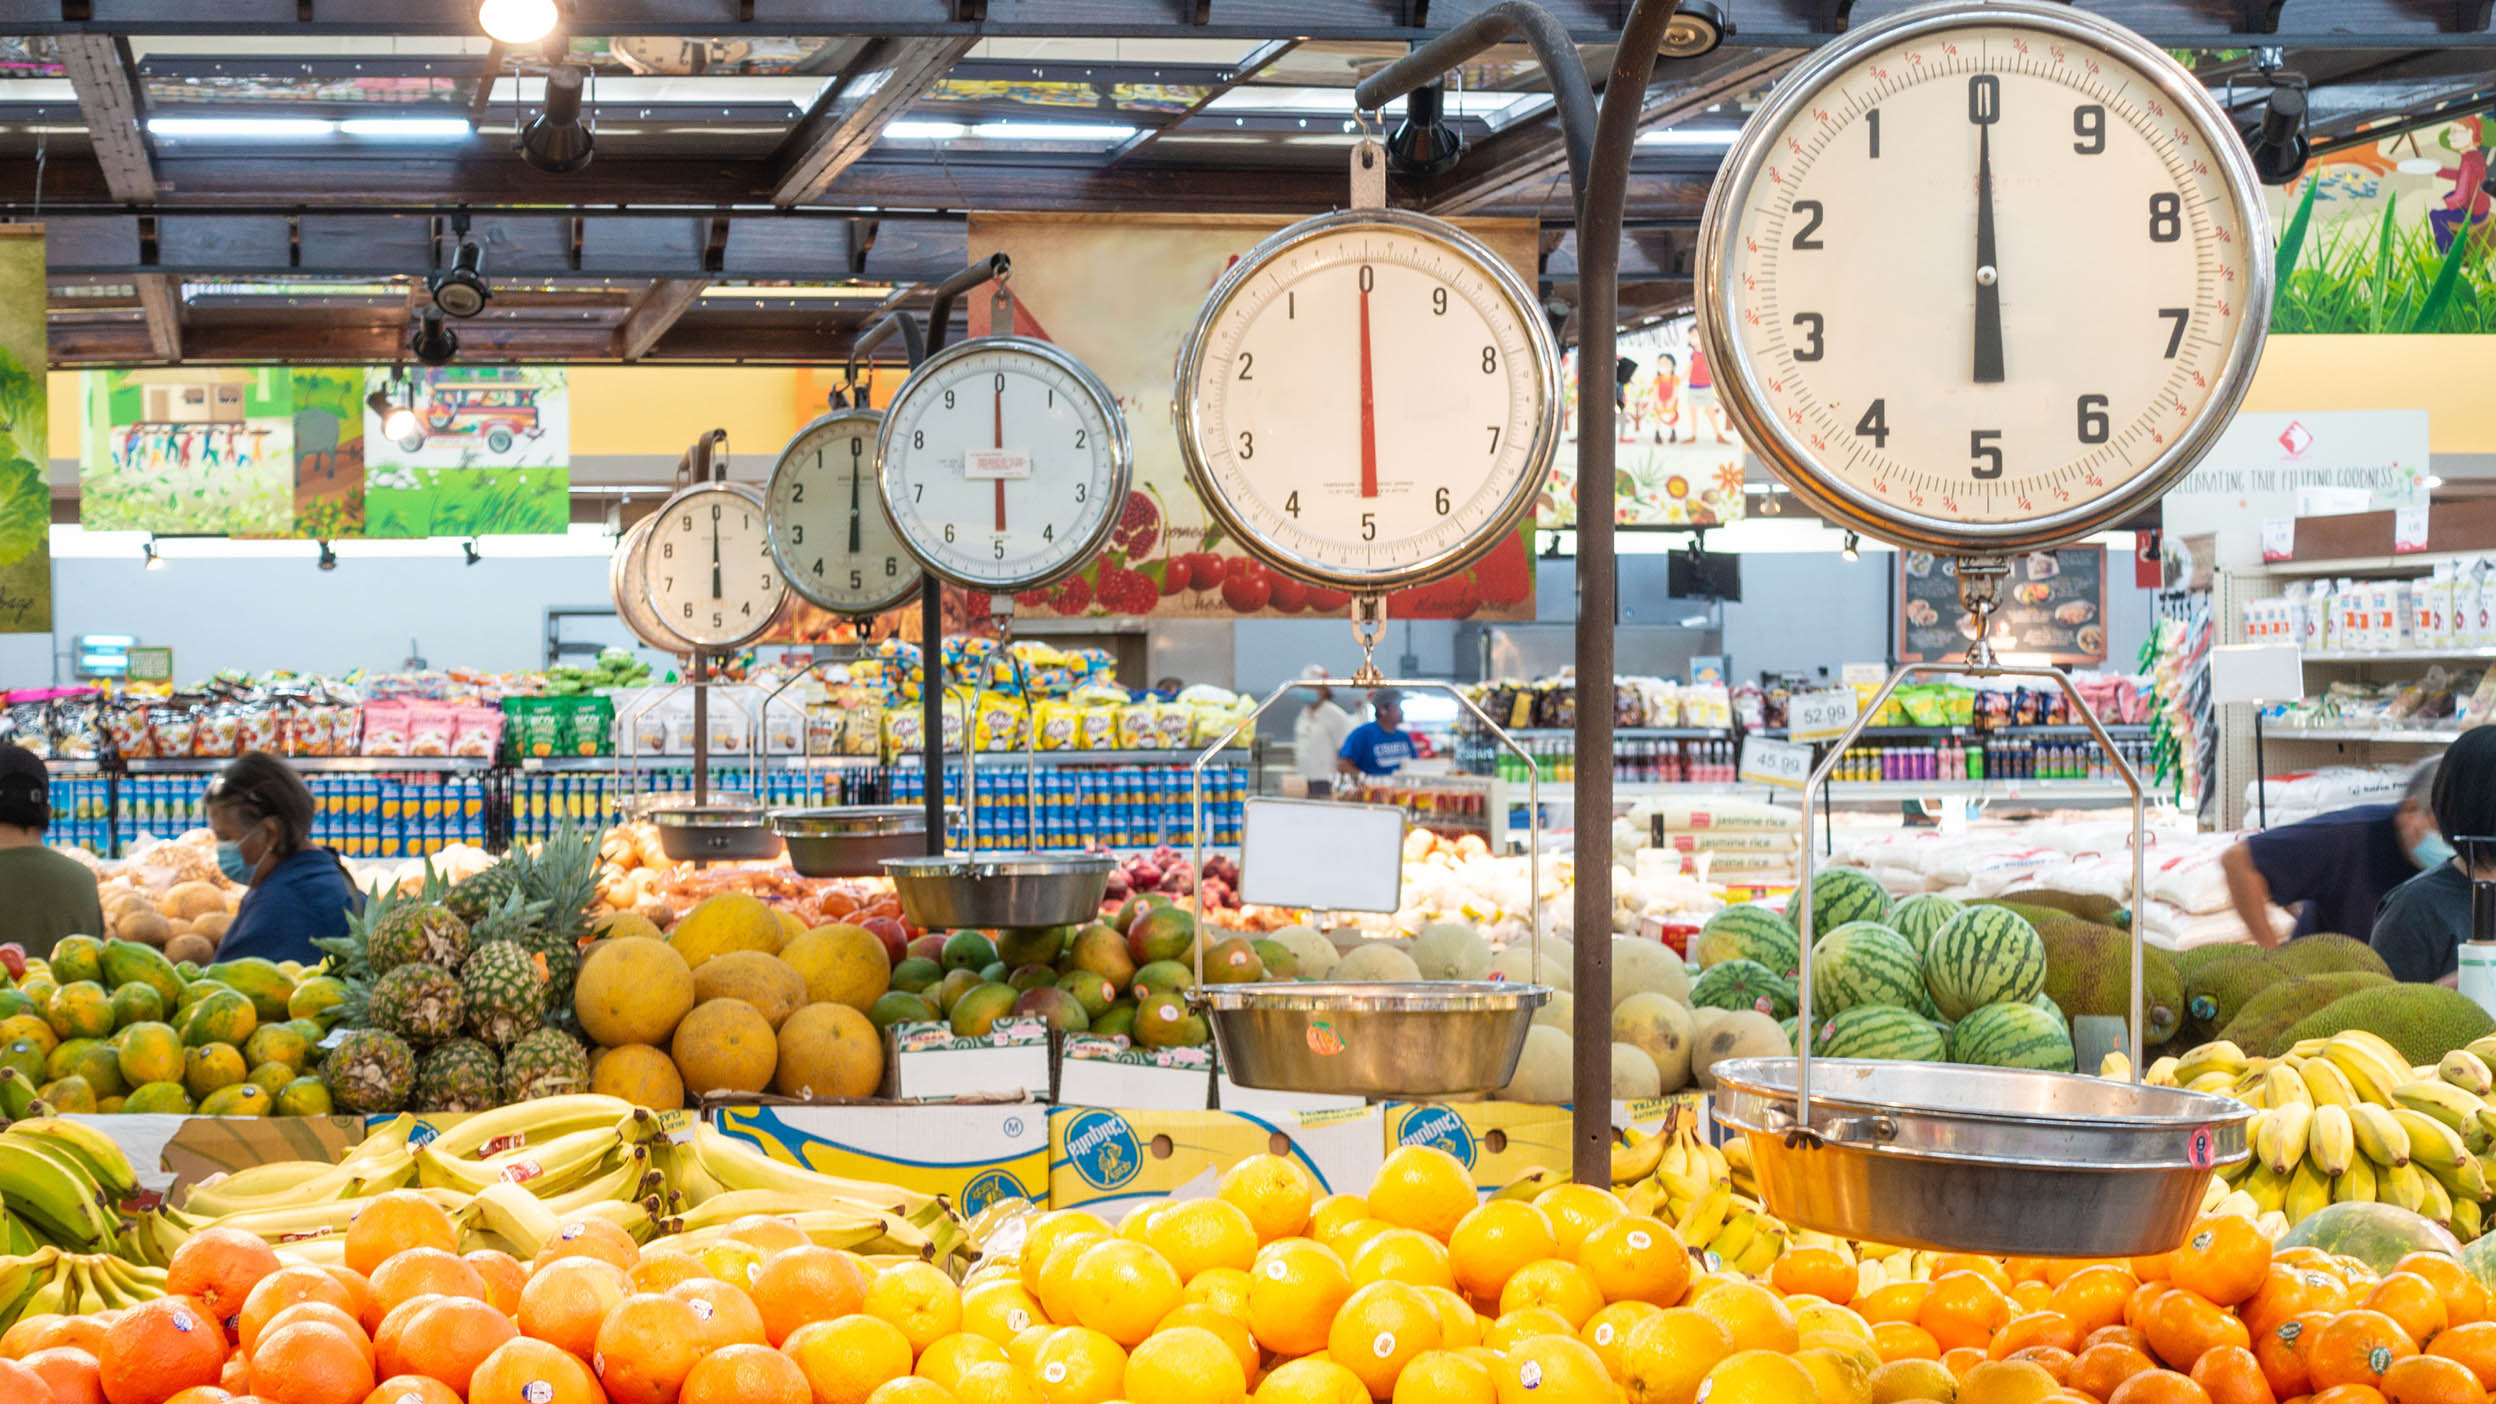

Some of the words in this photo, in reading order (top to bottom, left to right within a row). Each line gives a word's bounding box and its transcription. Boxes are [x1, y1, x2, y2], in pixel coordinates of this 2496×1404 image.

[1969, 75, 1999, 124] 0
[1866, 109, 1879, 158] 1
[2074, 105, 2105, 155] 9
[1792, 200, 1823, 250] 2
[2150, 192, 2181, 242] 8
[1359, 265, 1374, 293] 0
[1289, 292, 1294, 319] 1
[1433, 288, 1447, 315] 9
[1793, 313, 1823, 361] 3
[2159, 308, 2189, 358] 7
[1239, 353, 1252, 380] 2
[1482, 346, 1496, 374] 8
[995, 373, 1004, 392] 0
[945, 390, 954, 409] 9
[1049, 389, 1052, 408] 1
[1856, 399, 1889, 448] 4
[2078, 394, 2109, 444] 6
[852, 437, 862, 456] 0
[914, 431, 923, 449] 8
[1076, 430, 1085, 449] 2
[1240, 432, 1253, 459] 3
[1488, 427, 1500, 454] 7
[817, 449, 822, 468] 1
[1971, 430, 2002, 479] 5
[2252, 468, 2277, 492] TRUE
[2337, 465, 2394, 489] GOODNESS
[793, 484, 803, 502] 2
[915, 484, 923, 503] 7
[1076, 483, 1085, 503] 3
[1436, 488, 1449, 515] 6
[1286, 491, 1300, 518] 4
[683, 516, 692, 531] 9
[1043, 524, 1053, 542] 4
[1362, 514, 1375, 541] 5
[792, 526, 803, 544] 3
[945, 524, 954, 543] 6
[664, 543, 672, 558] 8
[761, 540, 771, 556] 2
[995, 541, 1004, 560] 5
[813, 558, 824, 576] 4
[886, 557, 896, 576] 6
[665, 577, 673, 592] 7
[762, 575, 770, 590] 3
[851, 571, 861, 590] 5
[684, 603, 692, 618] 6
[742, 602, 750, 616] 4
[713, 613, 721, 628] 5
[1804, 704, 1847, 724] 52.99
[1757, 752, 1801, 774] 45.99
[1716, 815, 1762, 829] jasmine
[1766, 815, 1787, 826] rice
[1699, 837, 1746, 849] jasmine
[1750, 837, 1771, 848] rice
[1748, 858, 1769, 867] rice
[1067, 1115, 1128, 1159] Chiquita
